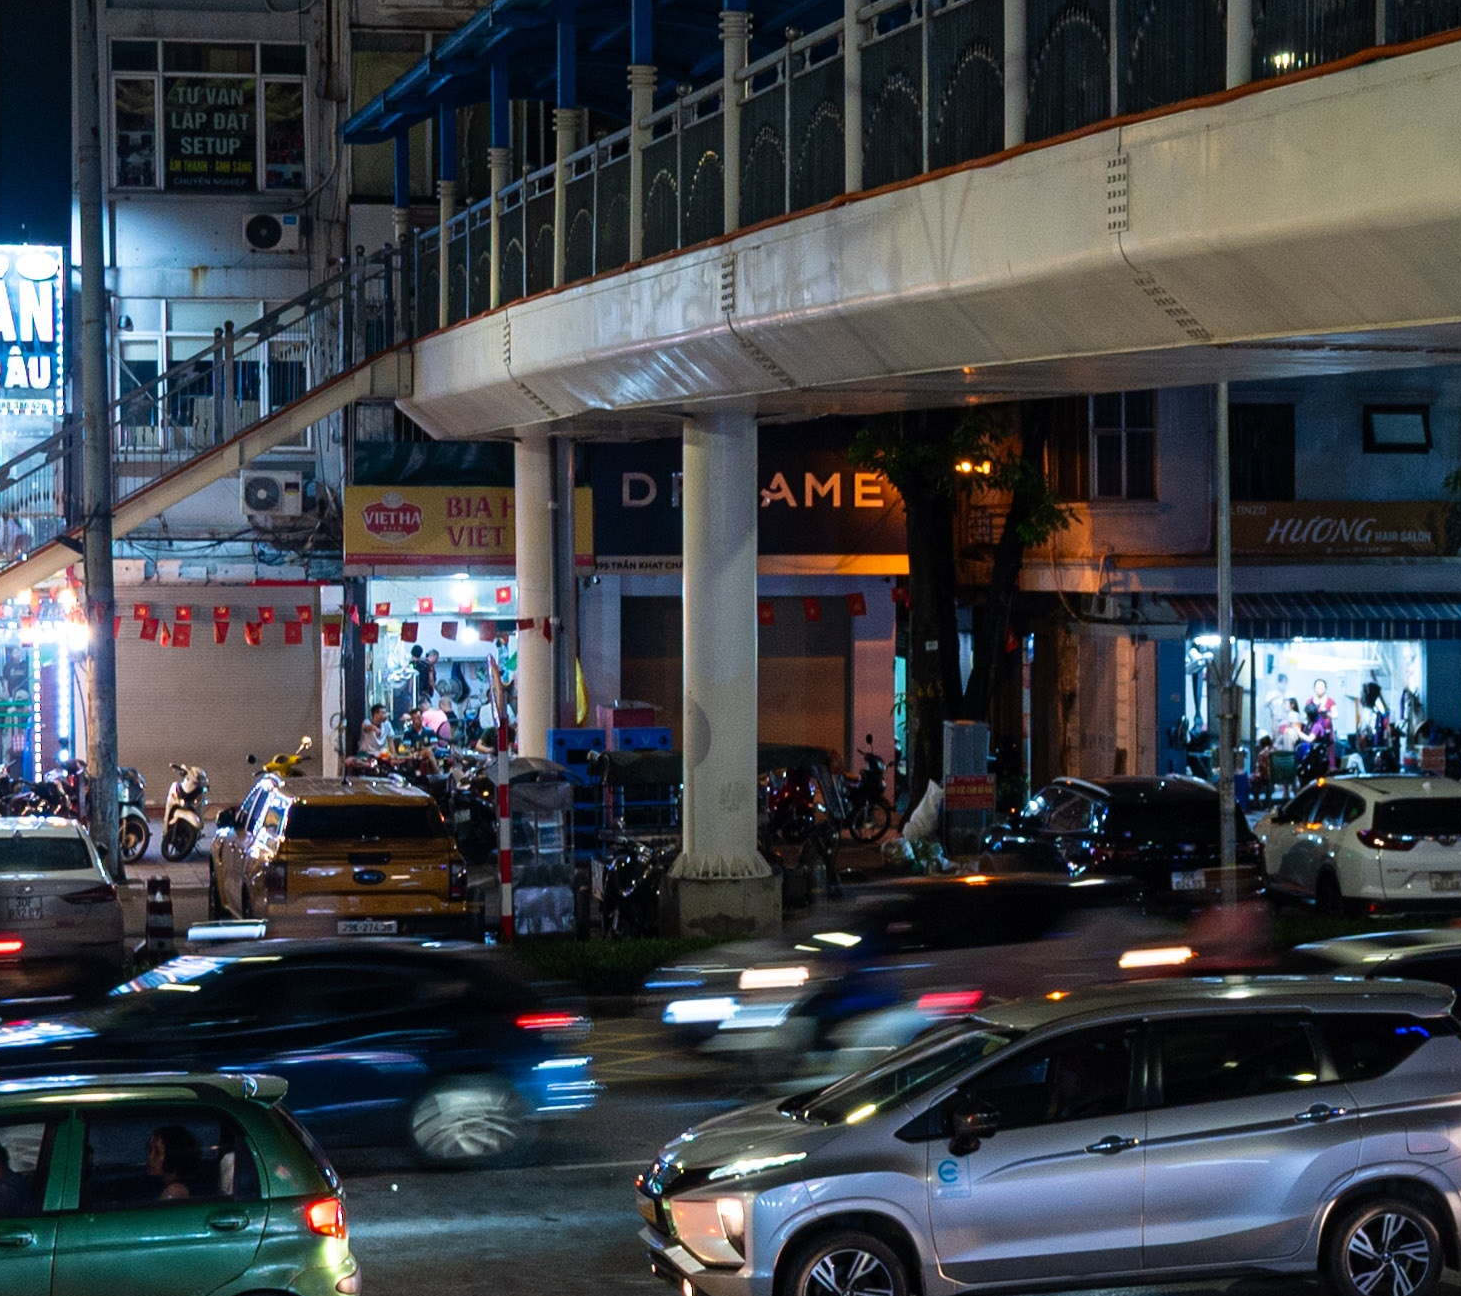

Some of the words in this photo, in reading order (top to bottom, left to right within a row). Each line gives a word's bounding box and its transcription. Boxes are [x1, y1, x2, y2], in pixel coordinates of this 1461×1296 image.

[179, 135, 242, 156] SETUP
[621, 471, 885, 509] DAME
[445, 496, 493, 520] BIA
